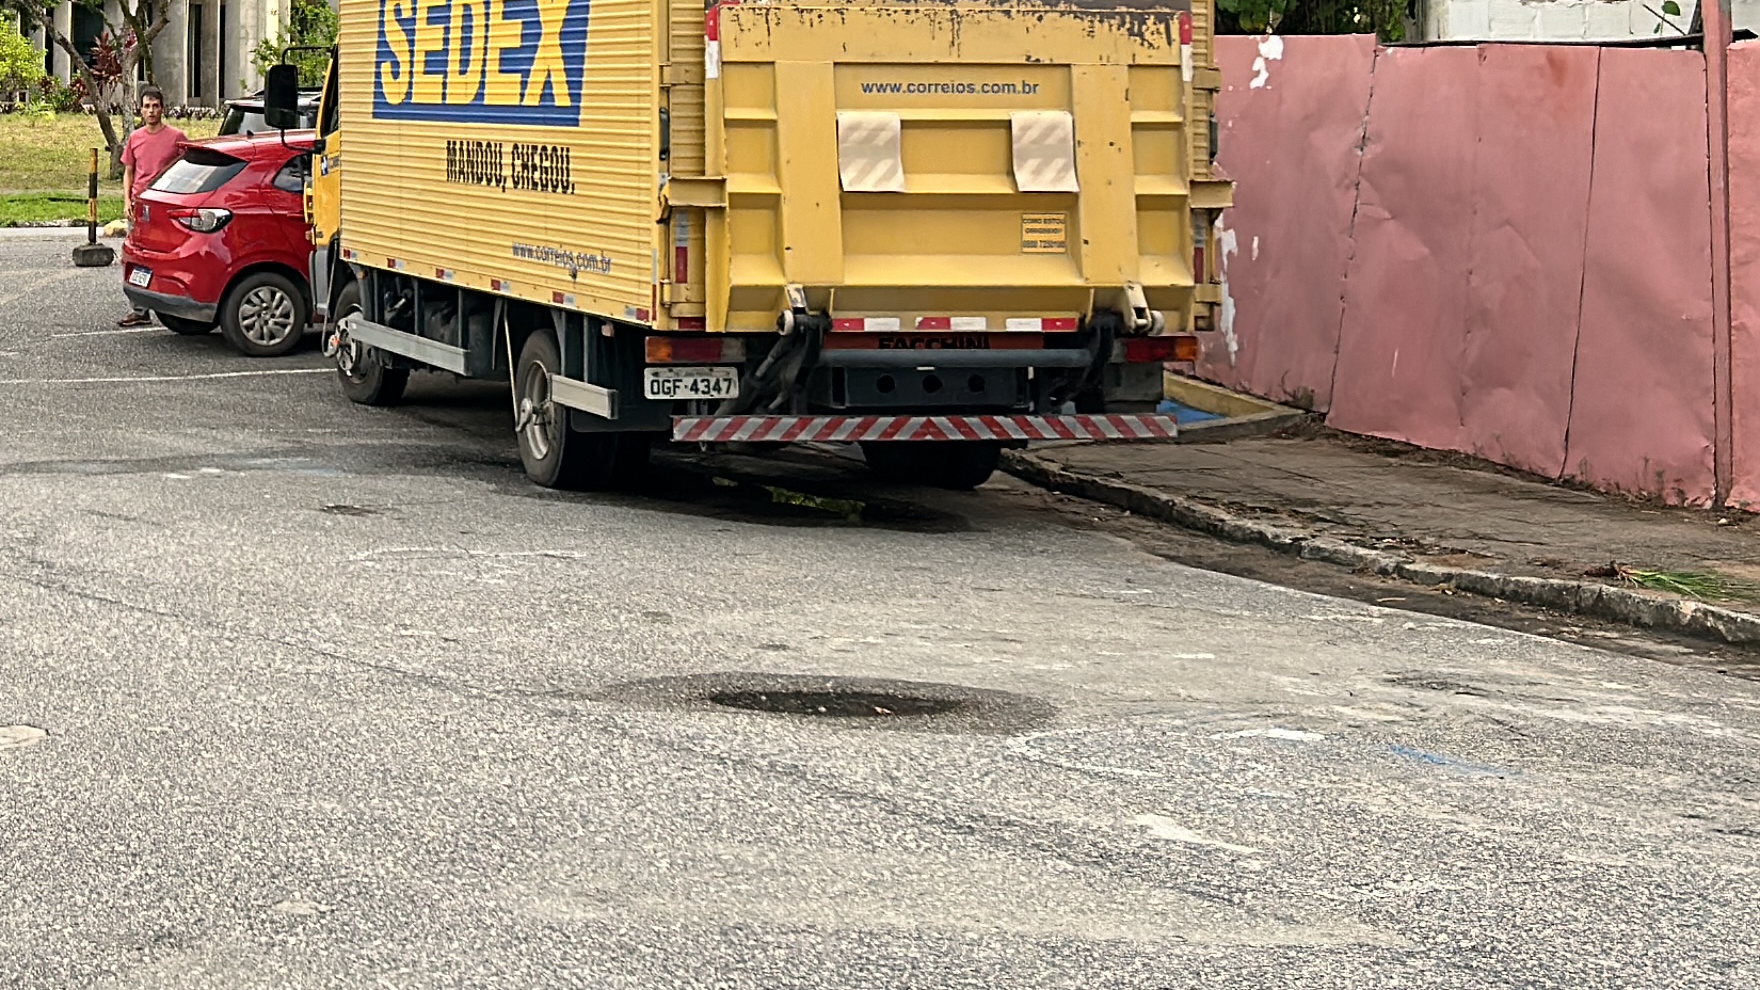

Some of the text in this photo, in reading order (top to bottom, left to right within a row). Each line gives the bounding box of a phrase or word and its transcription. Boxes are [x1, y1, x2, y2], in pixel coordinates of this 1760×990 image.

[861, 80, 1039, 94] www.correios.com.br
[446, 141, 575, 194] MANDOU, CHEGOU.
[512, 243, 611, 273] www.correios.com.br
